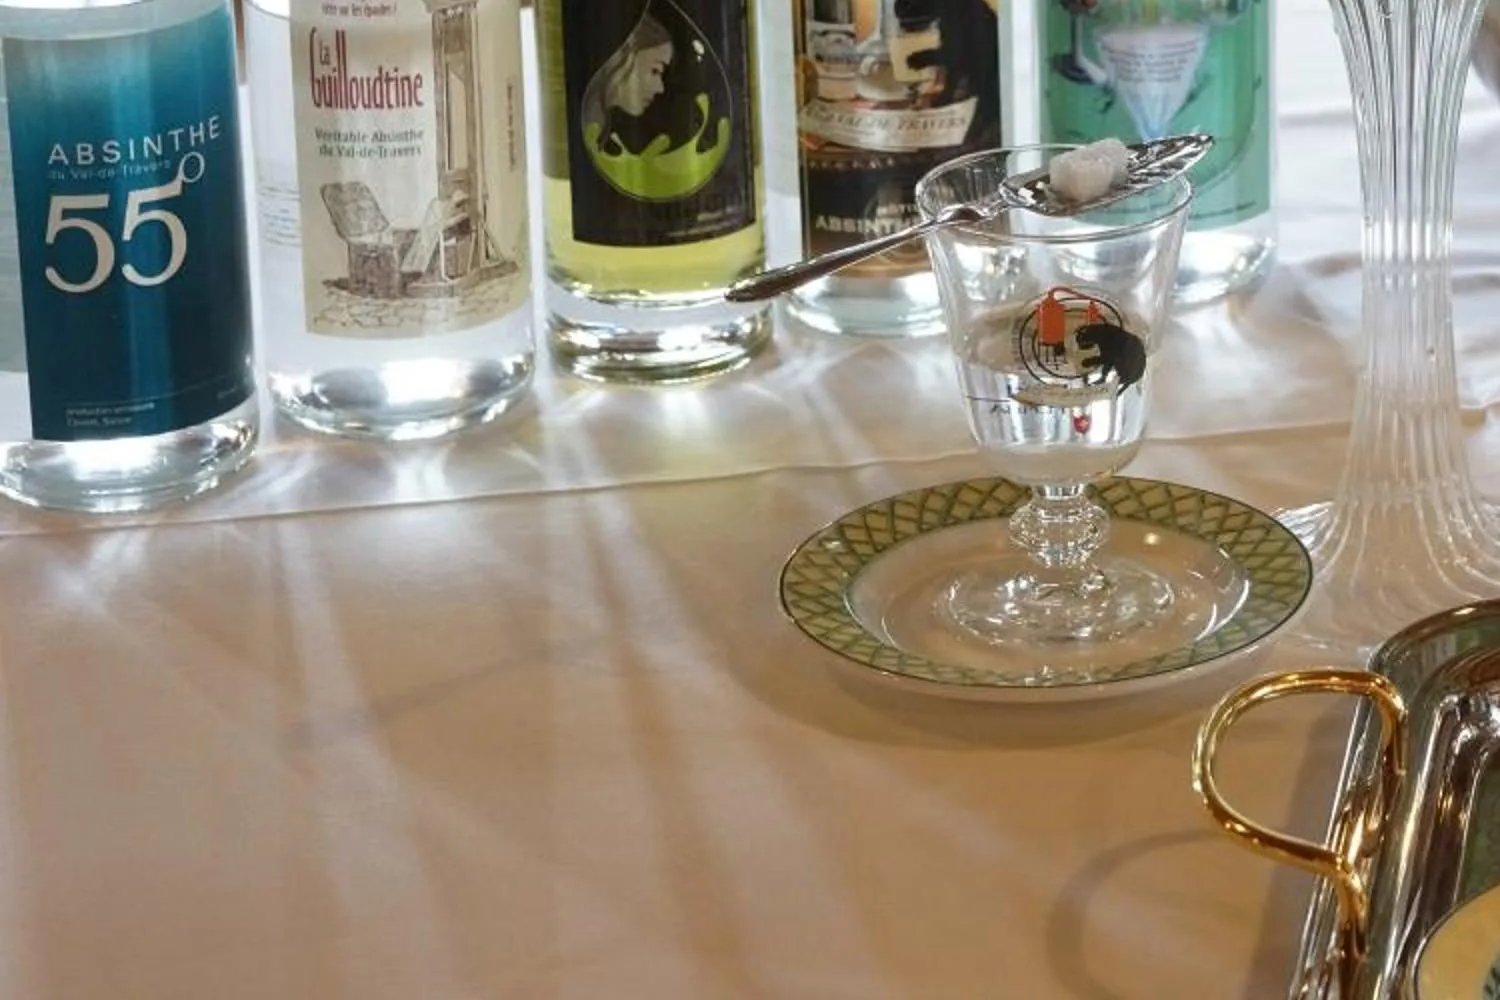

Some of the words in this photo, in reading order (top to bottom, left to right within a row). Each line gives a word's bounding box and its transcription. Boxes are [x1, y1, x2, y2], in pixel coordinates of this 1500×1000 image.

[309, 26, 425, 110] Guilloudtine
[48, 115, 221, 166] ABSINTHE
[815, 214, 905, 236] ABSINT
